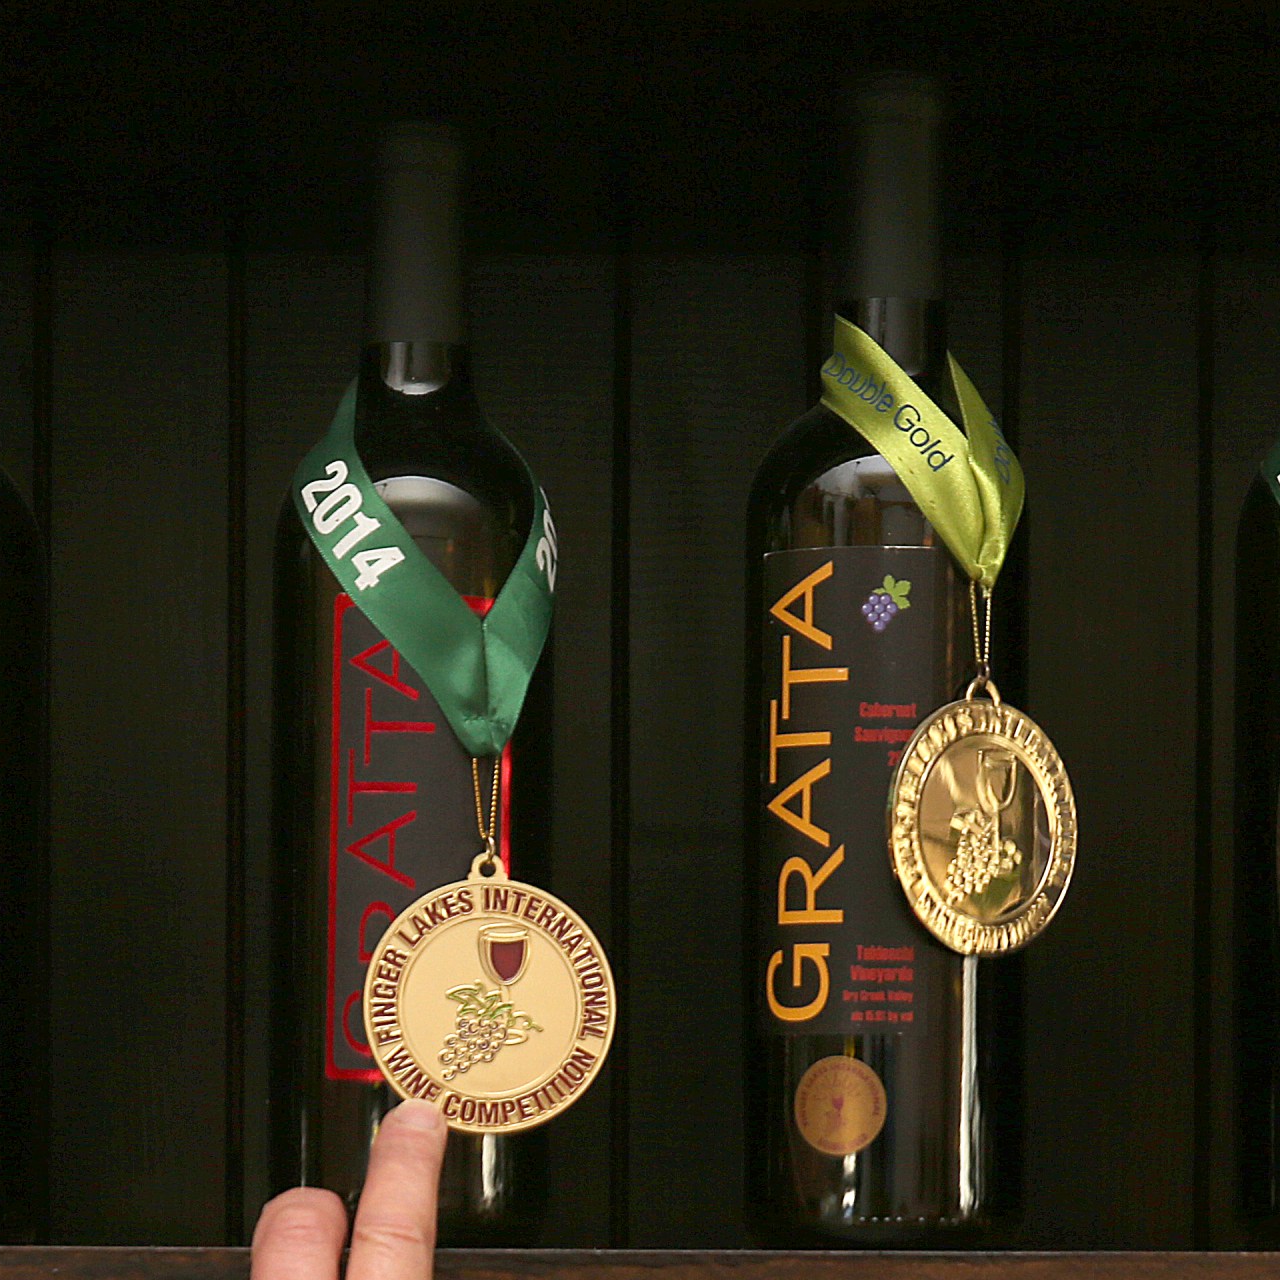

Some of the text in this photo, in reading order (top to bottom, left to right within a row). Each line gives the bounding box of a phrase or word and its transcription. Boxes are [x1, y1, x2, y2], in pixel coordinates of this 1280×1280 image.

[822, 353, 894, 413] Double
[893, 404, 954, 472] Gold
[301, 460, 405, 591] 2014
[766, 560, 850, 1022] GRATTA
[373, 887, 609, 1046] FINGER LAKES INTERNATIONAL
[385, 1047, 596, 1125] WINE COMPETITION
